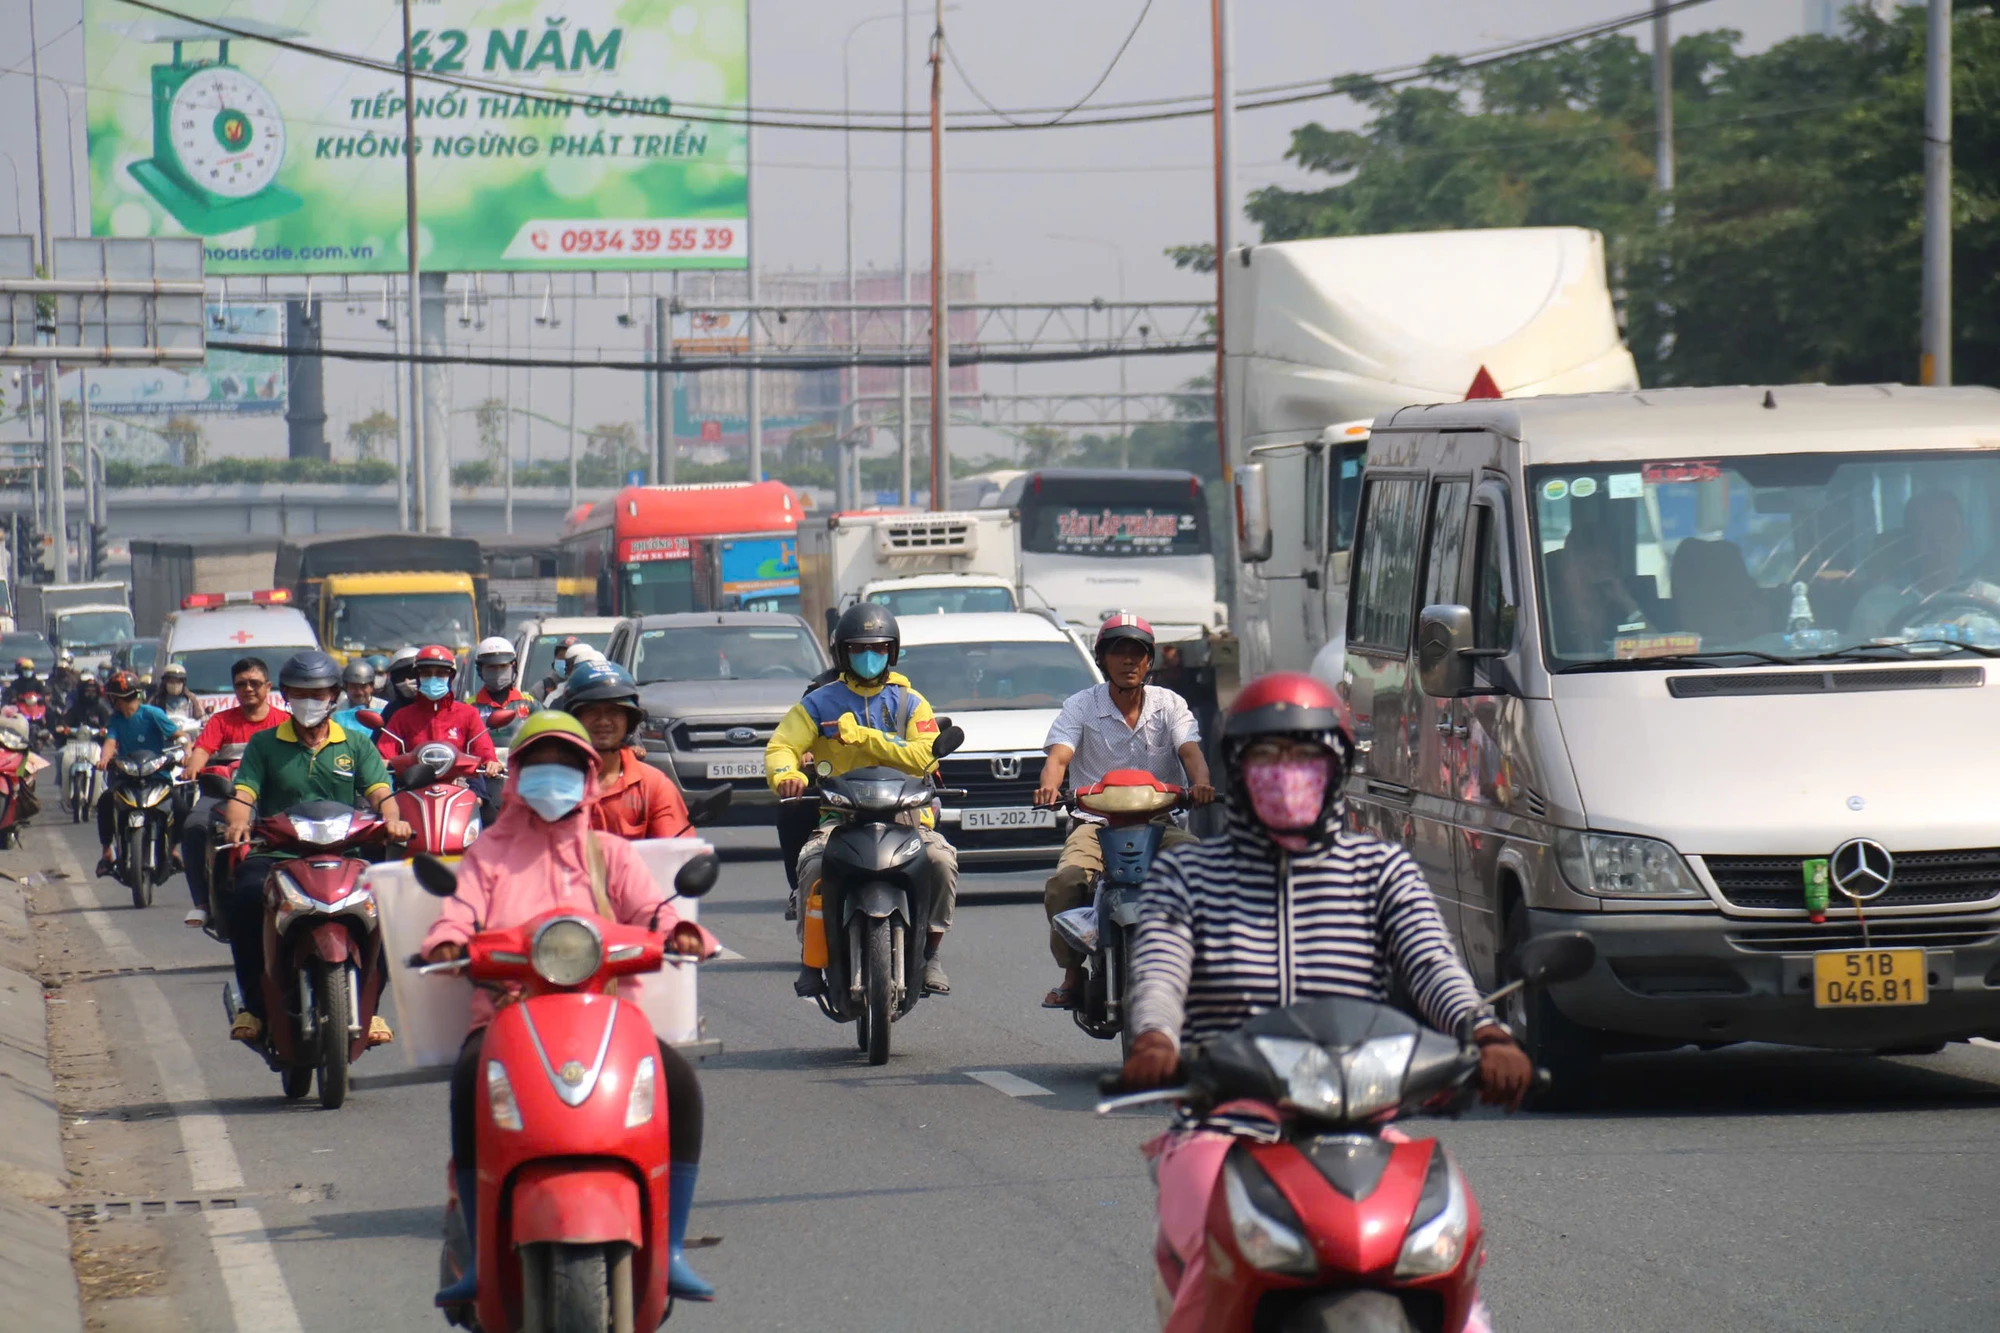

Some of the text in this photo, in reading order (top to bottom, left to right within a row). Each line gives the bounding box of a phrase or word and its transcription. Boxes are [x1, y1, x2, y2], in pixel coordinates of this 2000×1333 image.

[396, 17, 622, 72] 42 NĂM
[350, 88, 406, 119] TIẾP
[414, 86, 468, 119] NỐI
[315, 122, 708, 159] KHÔNG NGỪNG PHÁT TRIỂN
[560, 227, 734, 253] 0934 39 55 39
[203, 245, 373, 262] hoascale.com.vn
[969, 811, 1047, 826] 51L-202.77
[1845, 953, 1894, 977] 51B
[1827, 978, 1912, 1003] 046.81
